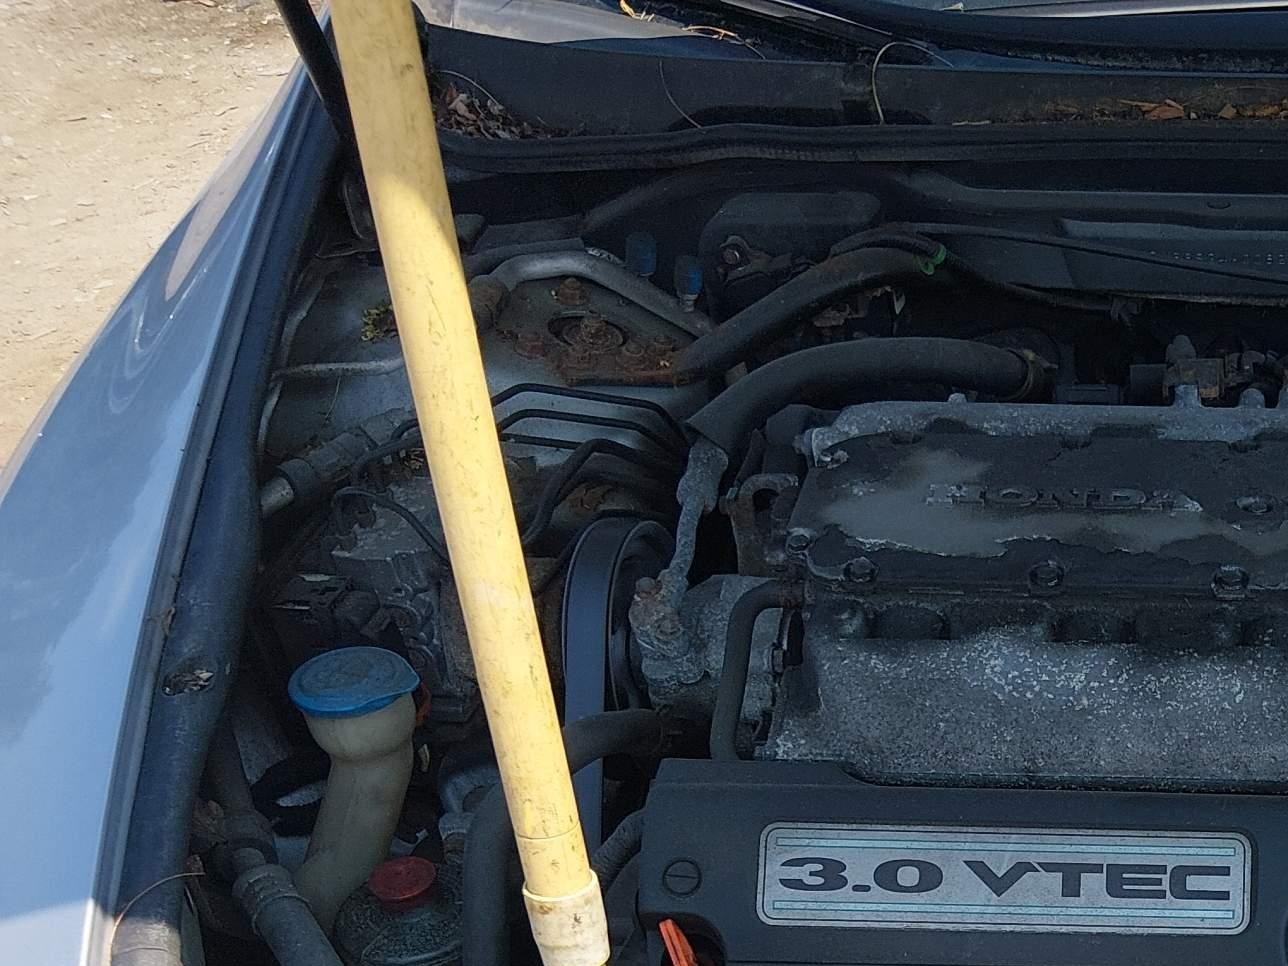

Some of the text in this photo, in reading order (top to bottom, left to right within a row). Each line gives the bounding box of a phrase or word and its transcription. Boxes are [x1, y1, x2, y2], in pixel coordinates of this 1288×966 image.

[926, 483, 1204, 513] HONDA
[778, 856, 1231, 901] 3.0 VTEC
